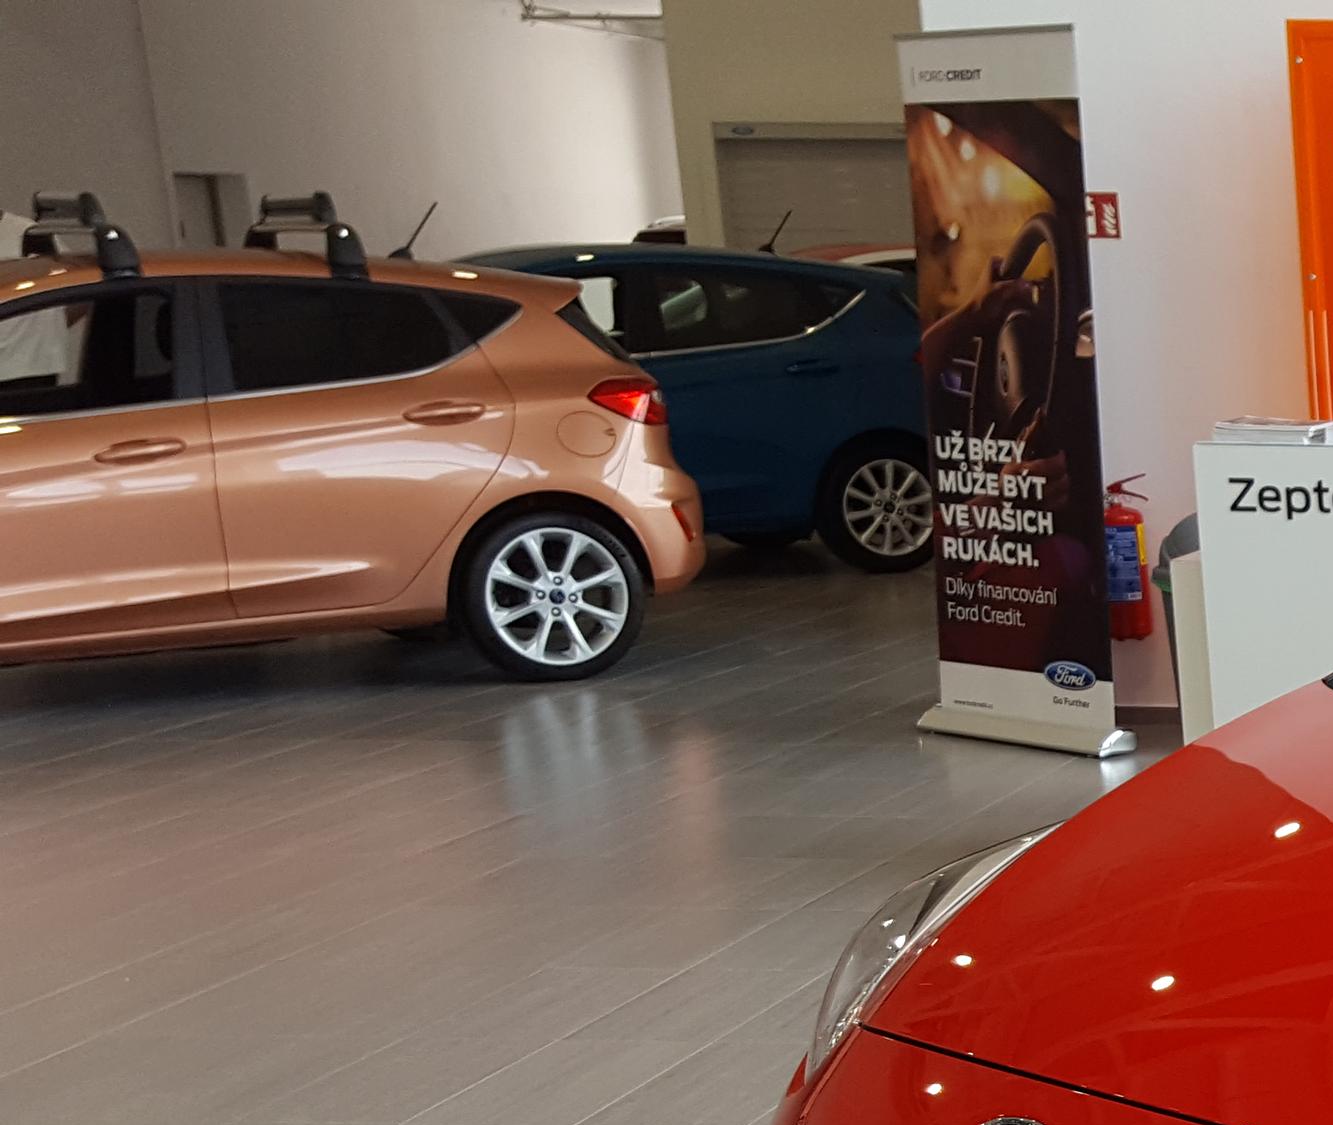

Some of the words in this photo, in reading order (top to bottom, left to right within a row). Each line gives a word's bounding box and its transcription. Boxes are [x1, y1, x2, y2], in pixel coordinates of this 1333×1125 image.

[946, 69, 982, 81] CREDIT
[935, 430, 966, 460] UŽ
[968, 437, 1026, 464] BRZY
[938, 461, 1000, 497] MŮŽE
[1003, 469, 1047, 500] BÝT
[940, 502, 970, 528] VE
[972, 502, 1054, 535] VAŠICH
[943, 534, 1040, 568] RUKÁCH.
[946, 576, 975, 599] Díky
[977, 579, 1058, 606] financování
[947, 601, 979, 621] Ford
[1053, 663, 1087, 688] Ford
[1052, 696, 1063, 705] Go
[1064, 696, 1091, 709] Further
